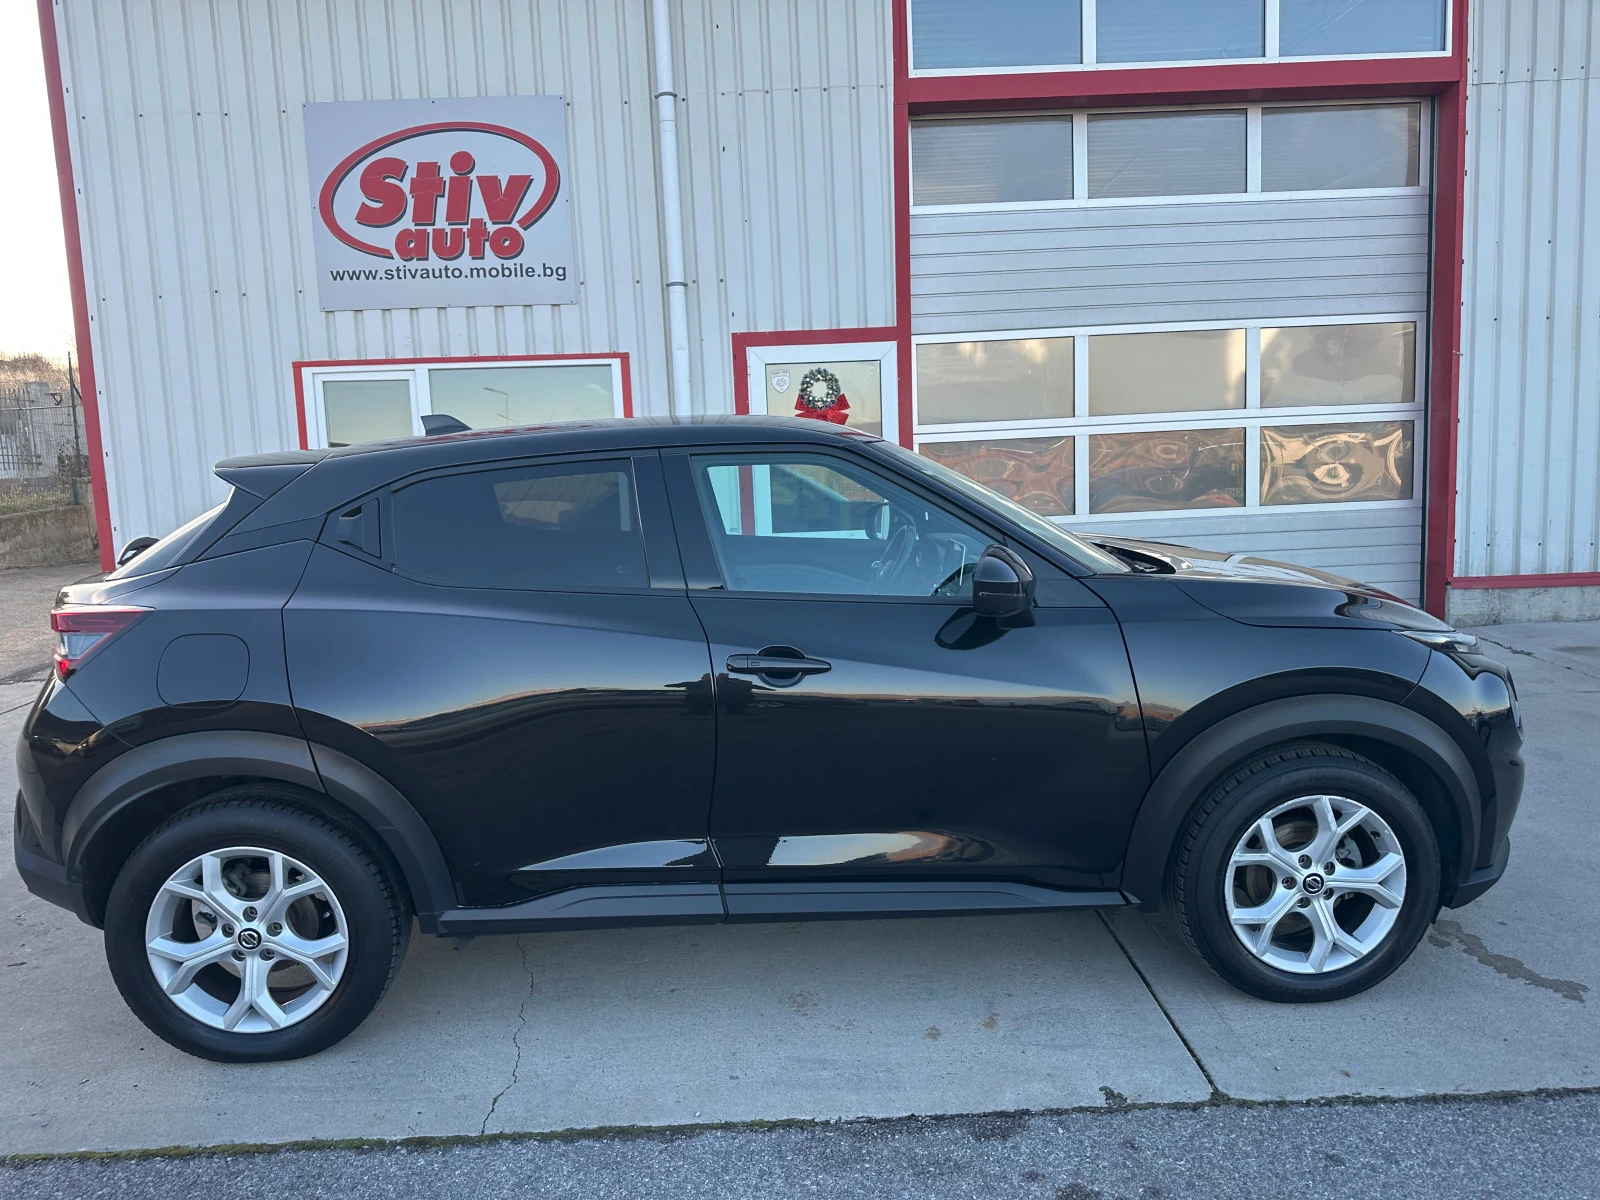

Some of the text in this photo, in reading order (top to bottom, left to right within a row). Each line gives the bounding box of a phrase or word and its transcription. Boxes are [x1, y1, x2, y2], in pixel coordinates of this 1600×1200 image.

[355, 151, 534, 228] Stiv
[394, 218, 525, 261] auto
[330, 263, 567, 282] www.stivauto.mobile.bg
